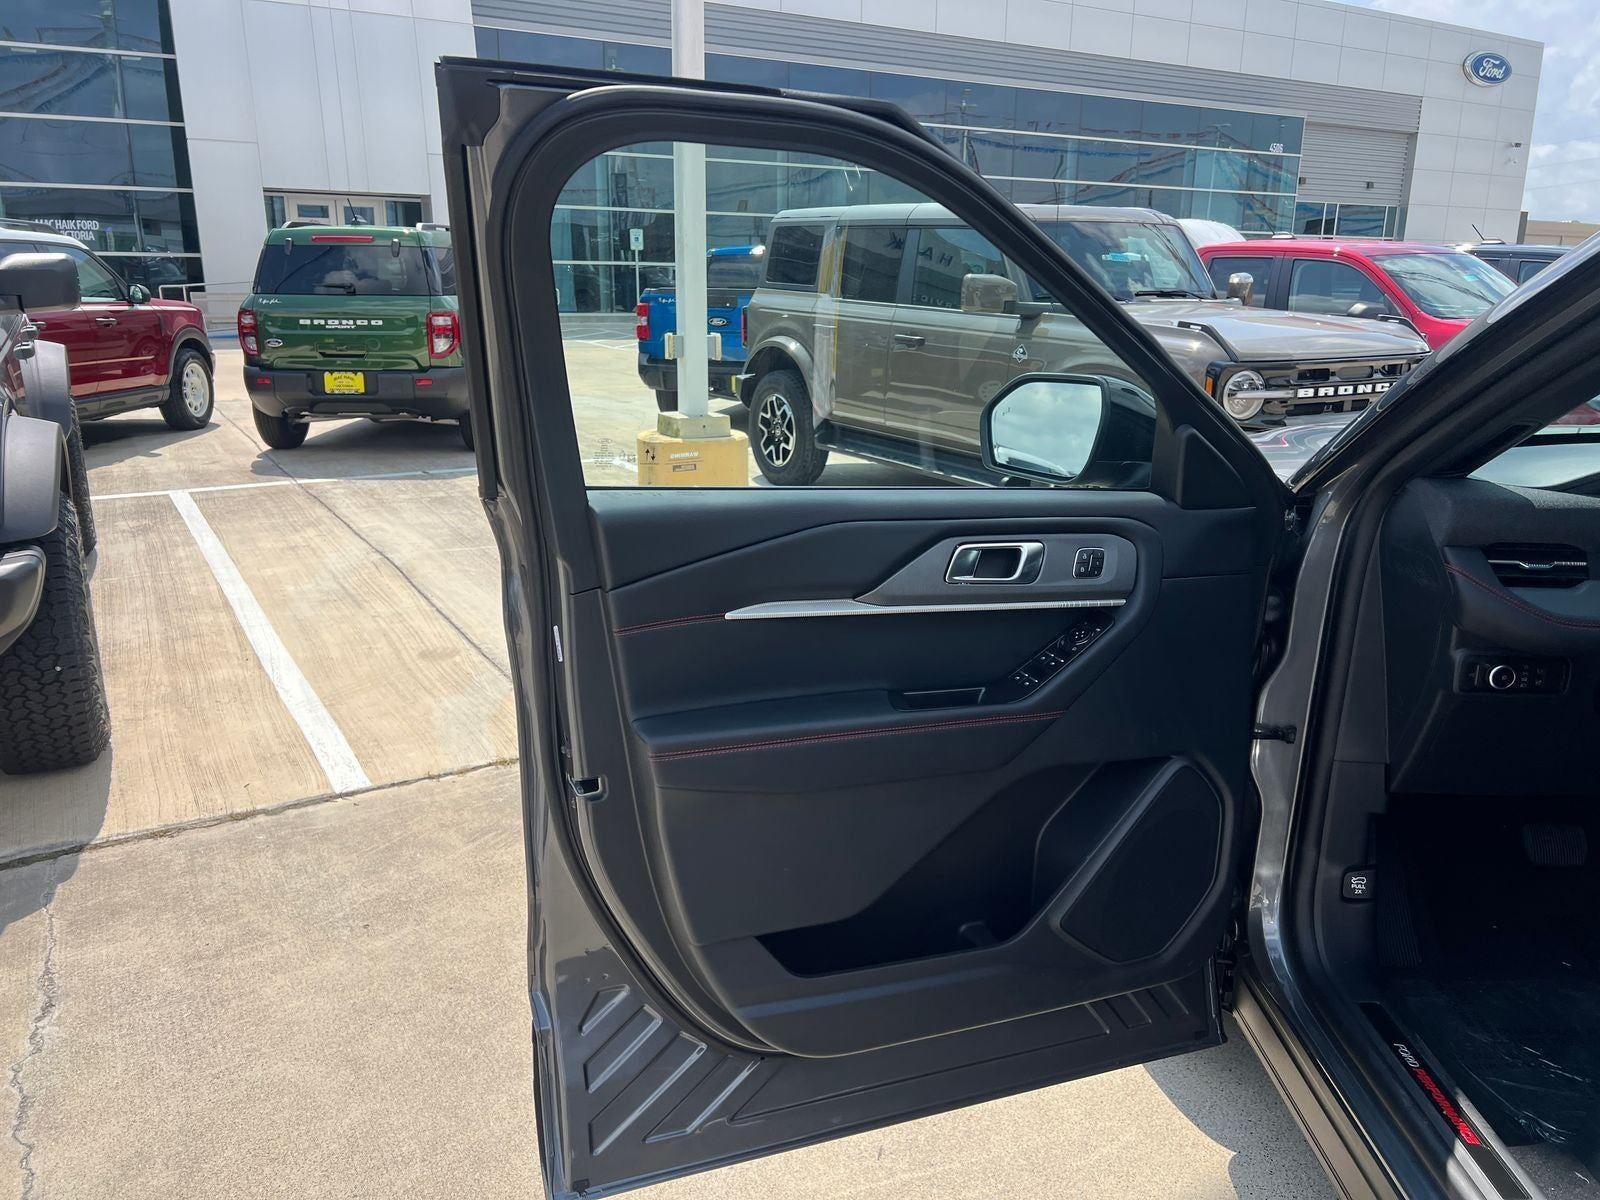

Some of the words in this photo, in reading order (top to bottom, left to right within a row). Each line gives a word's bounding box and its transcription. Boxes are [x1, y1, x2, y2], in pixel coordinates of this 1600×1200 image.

[1479, 57, 1506, 79] Ford
[54, 219, 76, 230] HAIK
[76, 220, 100, 230] FORD
[1297, 382, 1397, 399] BRONC
[1393, 1043, 1420, 1068] FORD
[1413, 1067, 1481, 1146] PERFORMANCE
